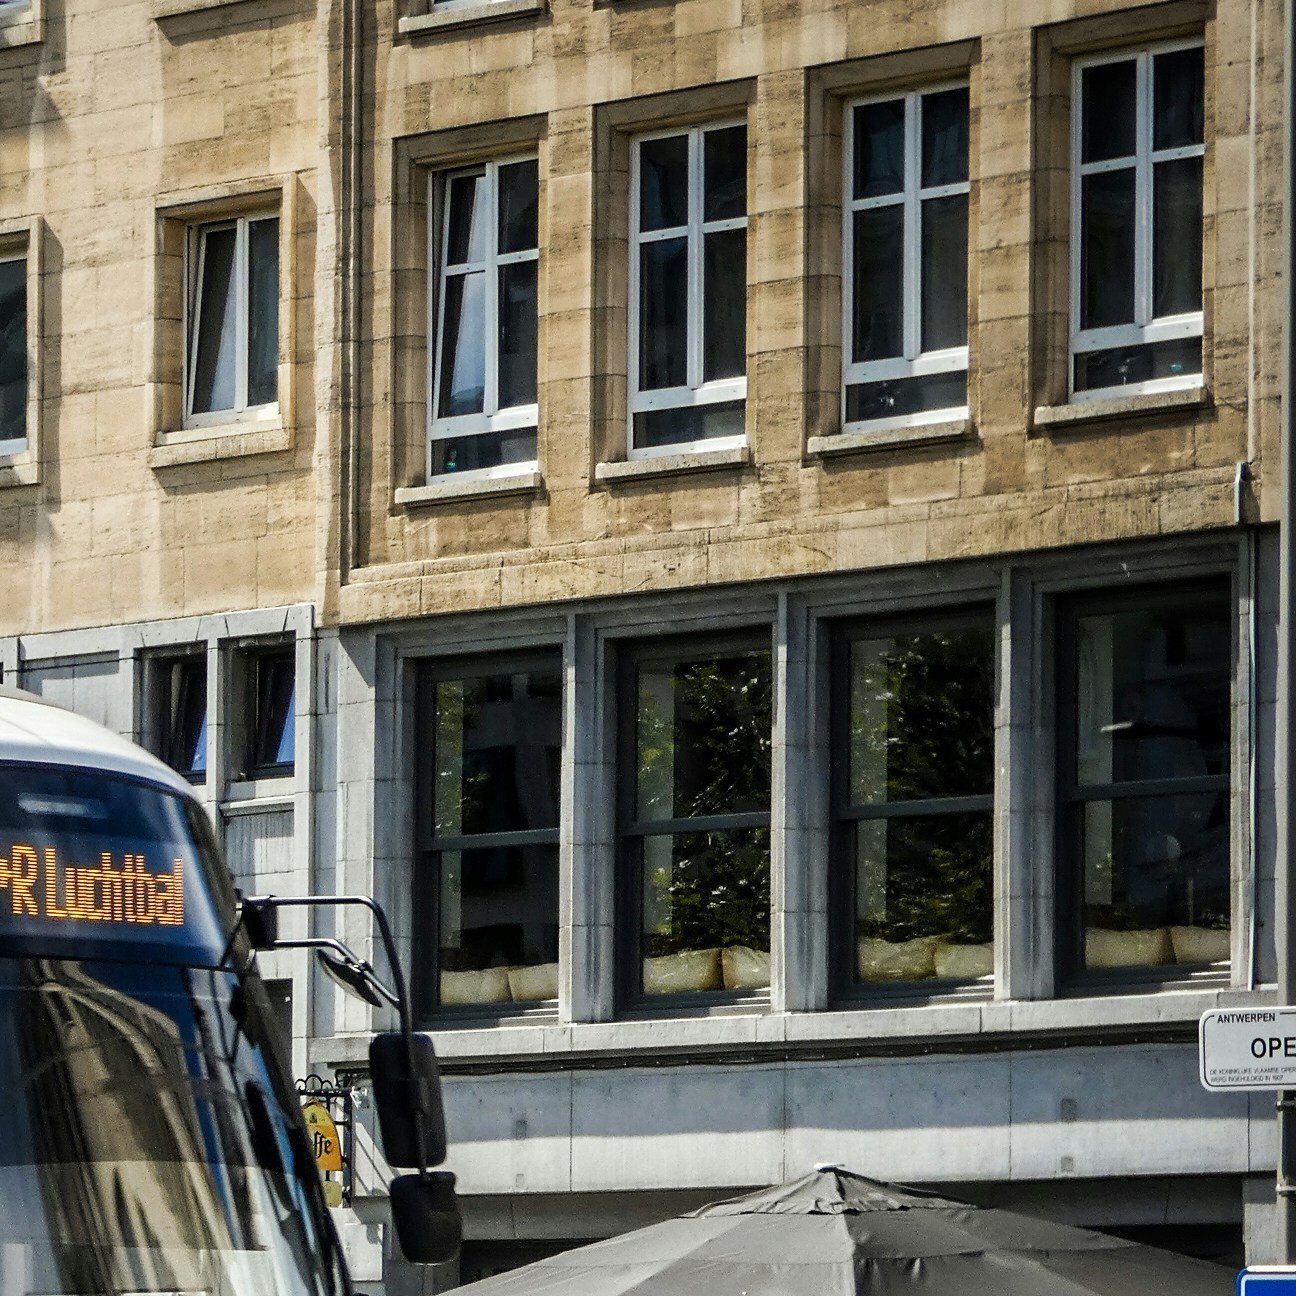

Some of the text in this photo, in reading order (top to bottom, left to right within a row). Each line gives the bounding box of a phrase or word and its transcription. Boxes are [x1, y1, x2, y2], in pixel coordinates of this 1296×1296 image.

[45, 846, 185, 926] Luchtbal
[1217, 1013, 1276, 1024] ANTWERPEN
[1250, 1037, 1296, 1058] OPE
[314, 1130, 334, 1159] ffe
